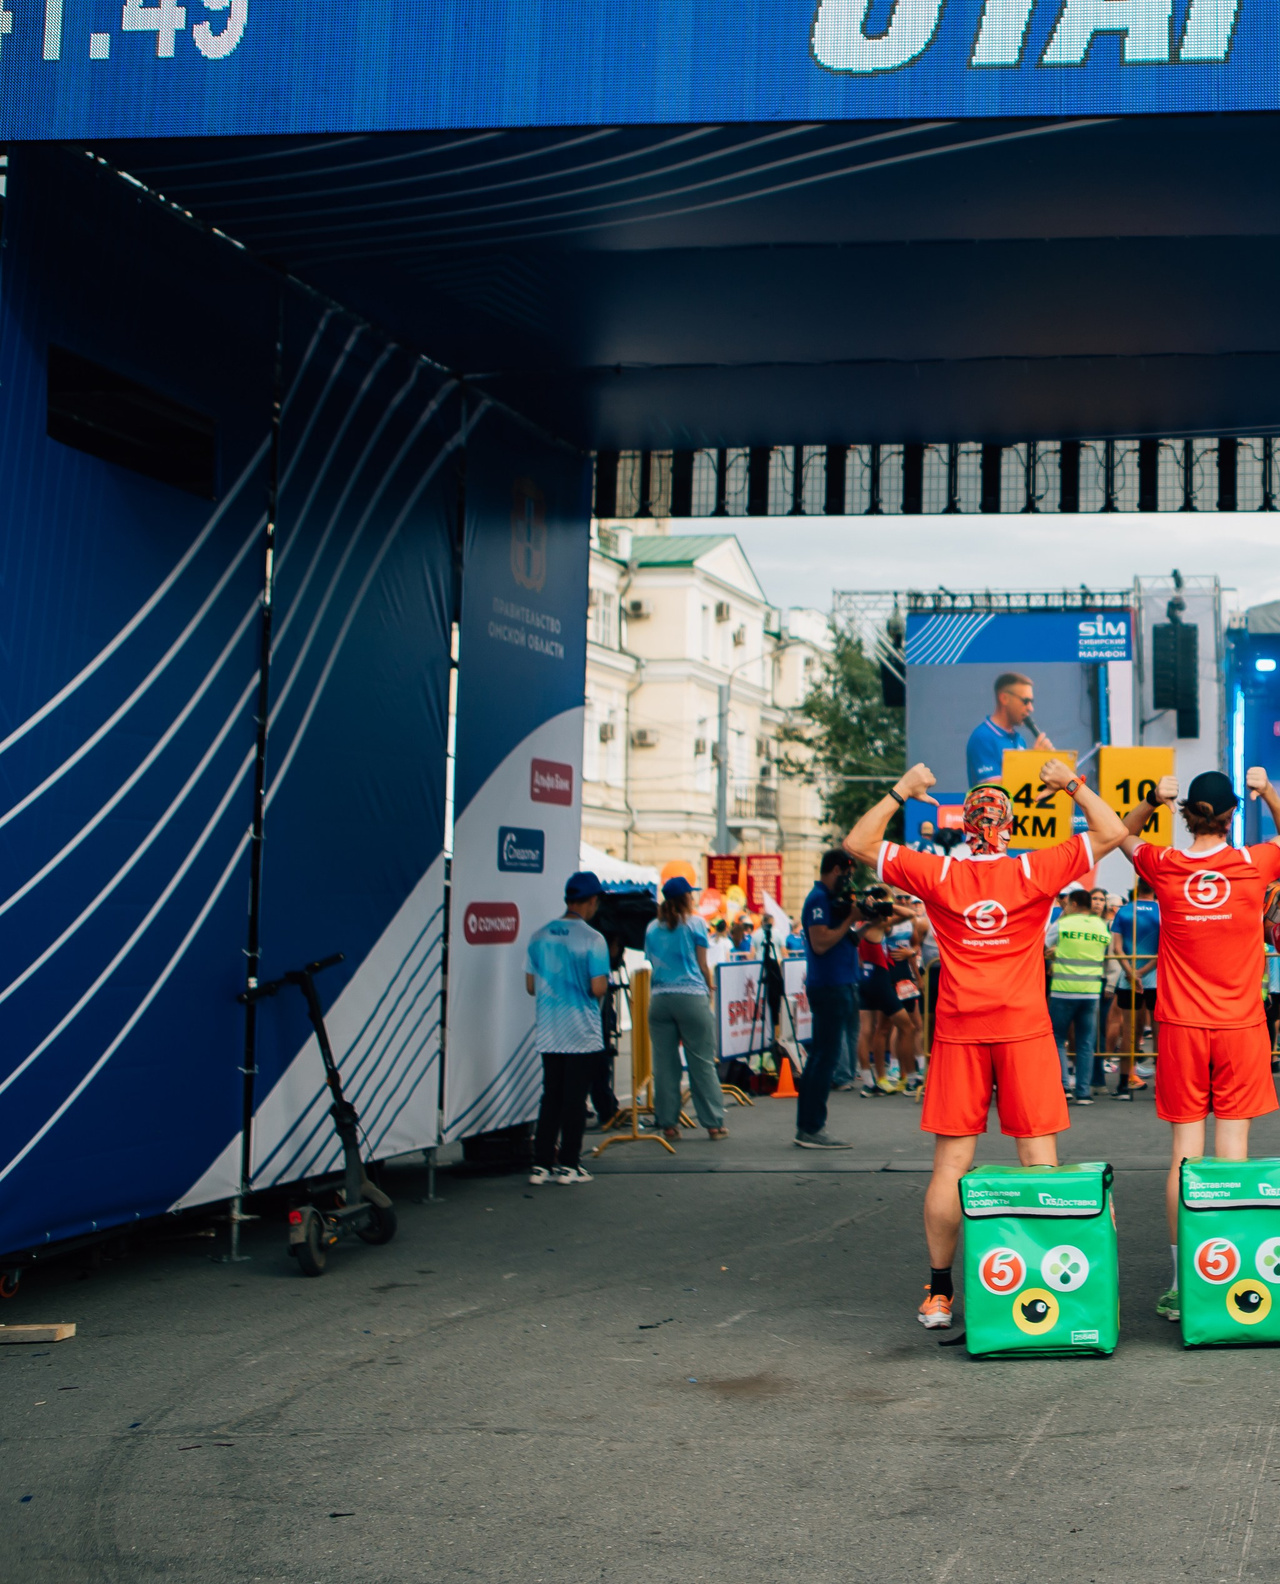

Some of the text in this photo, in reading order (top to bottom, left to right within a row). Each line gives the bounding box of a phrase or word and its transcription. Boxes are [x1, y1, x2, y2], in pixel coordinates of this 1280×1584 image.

[528, 634, 565, 659] ОБЛАСТИ
[1079, 637, 1126, 645] СИБИРСКИЙ
[1079, 650, 1126, 658] МАРАФОН
[1012, 783, 1056, 809] 42
[1116, 779, 1156, 804] 10
[1197, 872, 1220, 902] 5
[976, 903, 998, 928] 5
[1062, 931, 1110, 944] REFEREE
[967, 1190, 1021, 1198] Доставляем
[1188, 1181, 1241, 1190] Доставляем
[1189, 1191, 1231, 1199] продукты
[968, 1199, 1010, 1207] продукты
[991, 1251, 1016, 1286] 5
[1205, 1243, 1230, 1276] 5
